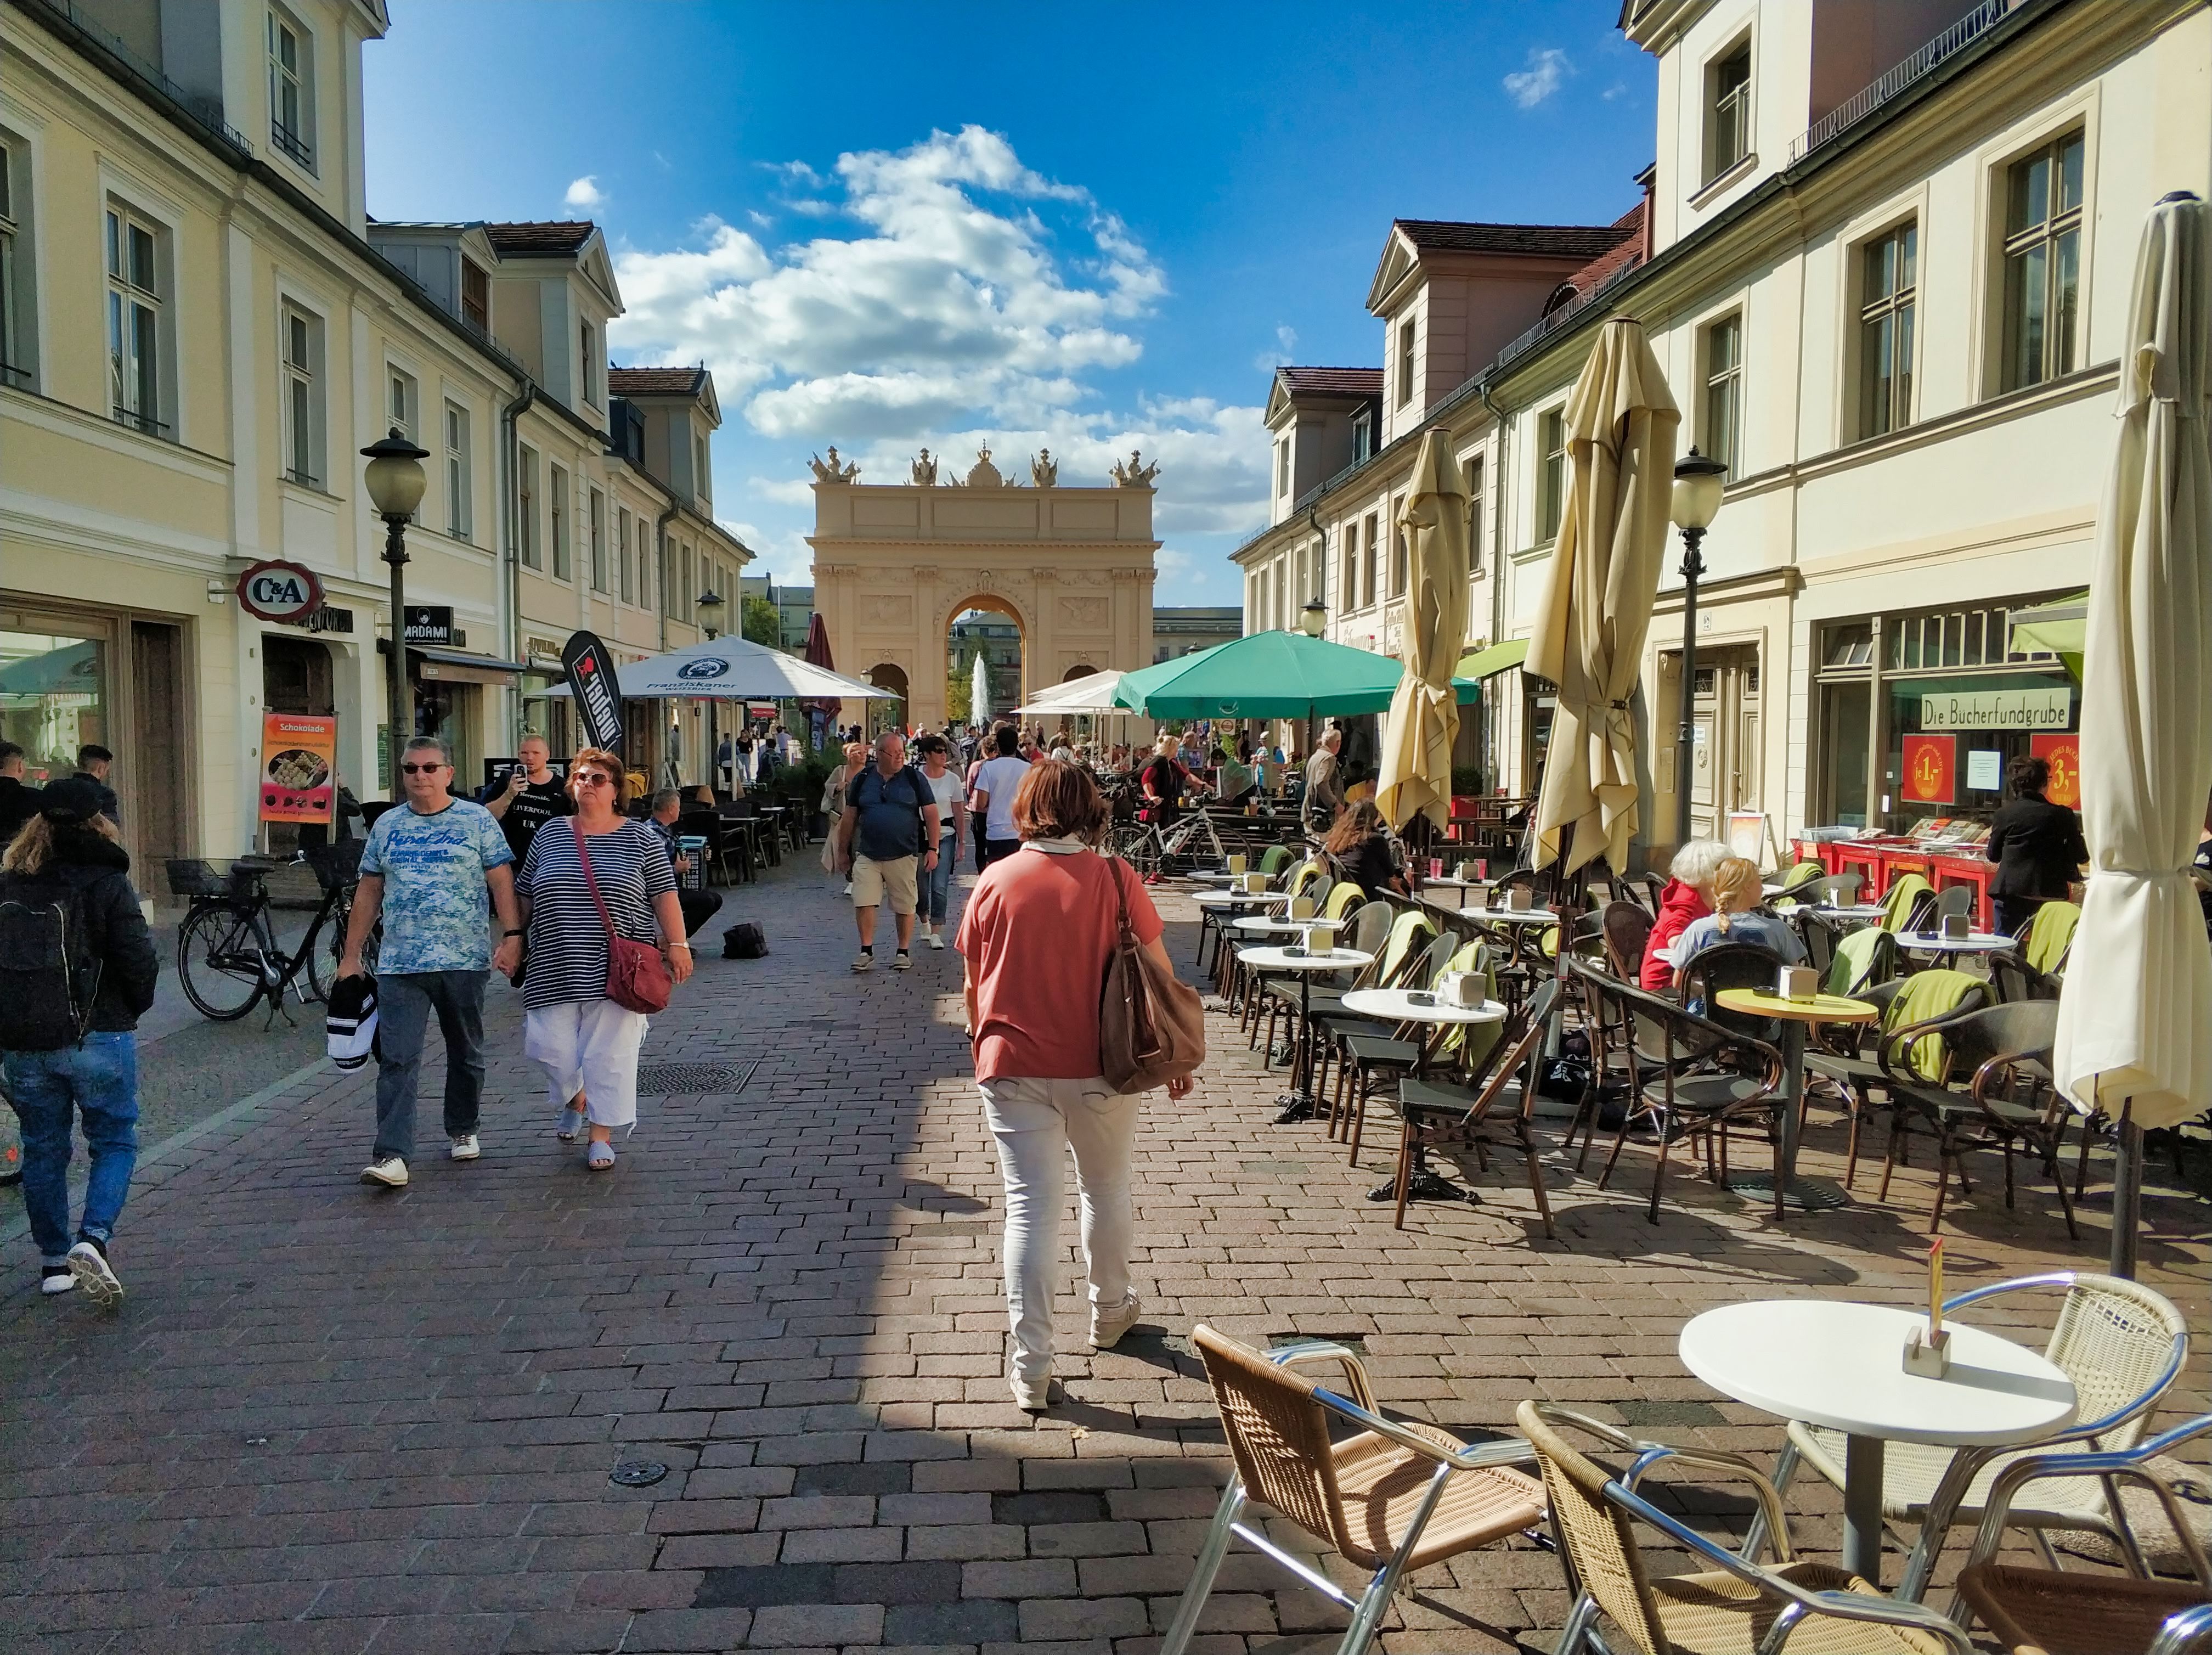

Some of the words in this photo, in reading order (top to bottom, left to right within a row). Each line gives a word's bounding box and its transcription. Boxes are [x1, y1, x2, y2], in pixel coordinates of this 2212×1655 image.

[252, 577, 305, 603] C&A
[1924, 699, 1944, 725] Die
[1949, 695, 2066, 727] Bücherfundgrube
[280, 723, 325, 733] Schokolade
[2050, 745, 2065, 764] JEDES
[1915, 766, 1922, 780] je
[513, 804, 552, 816] LIVERPOOL
[523, 819, 537, 829] UK
